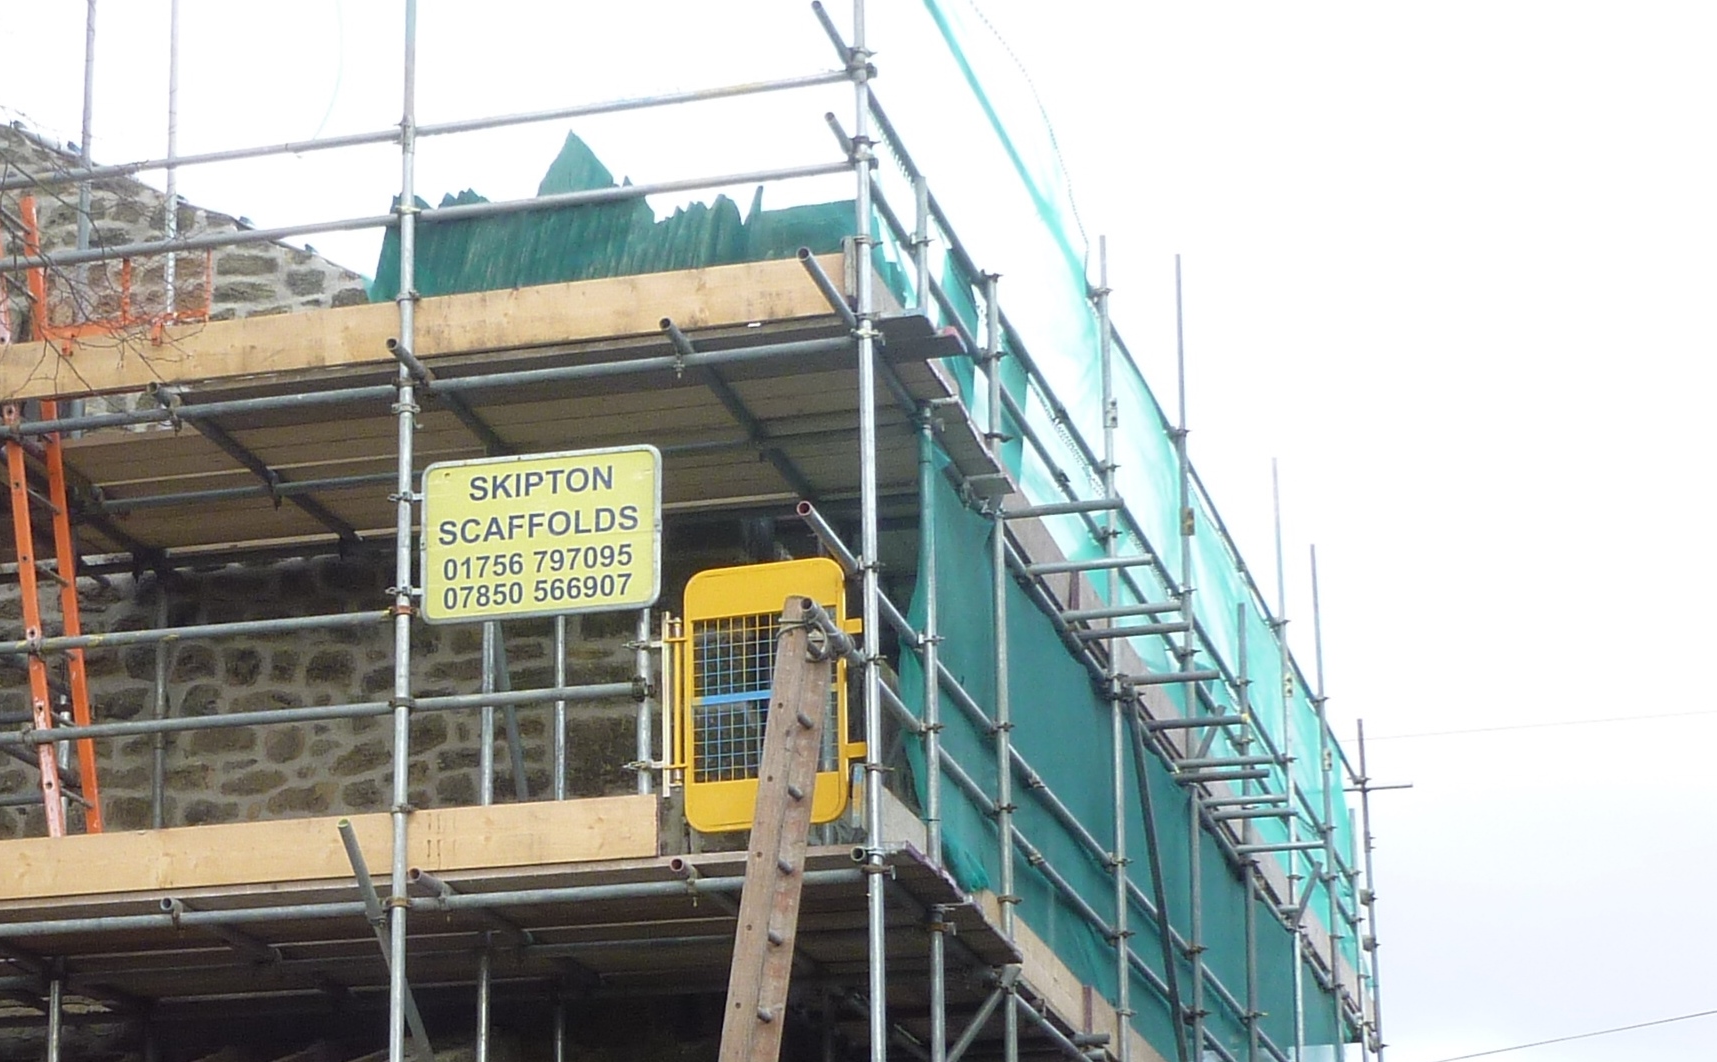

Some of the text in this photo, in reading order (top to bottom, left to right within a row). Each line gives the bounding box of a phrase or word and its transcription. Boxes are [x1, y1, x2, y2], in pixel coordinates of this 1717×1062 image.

[469, 465, 613, 501] SKIPTON
[438, 505, 639, 546] SCAFFOLDS
[443, 543, 632, 581] 01756 797095
[443, 573, 632, 610] 07850 566907
